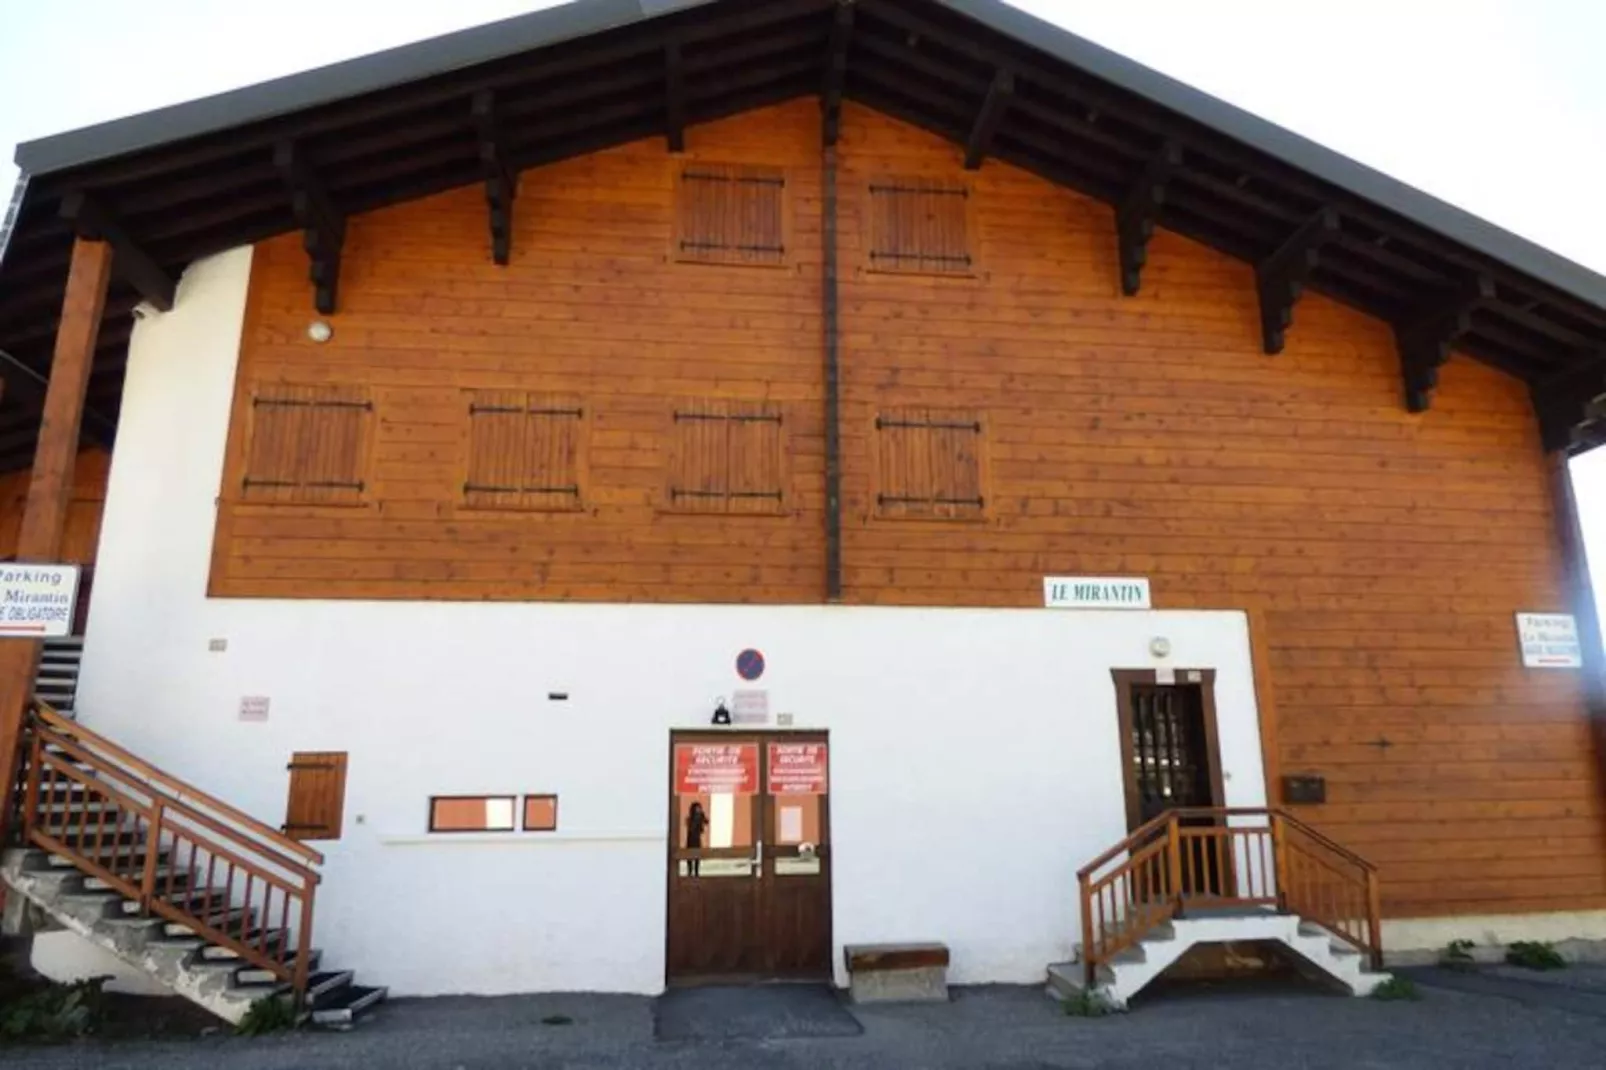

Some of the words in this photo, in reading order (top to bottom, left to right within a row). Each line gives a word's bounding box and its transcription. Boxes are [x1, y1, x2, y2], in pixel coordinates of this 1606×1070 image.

[4, 589, 69, 603] Mirantin
[1052, 583, 1068, 601] LE
[1073, 583, 1142, 602] MIRANTIN
